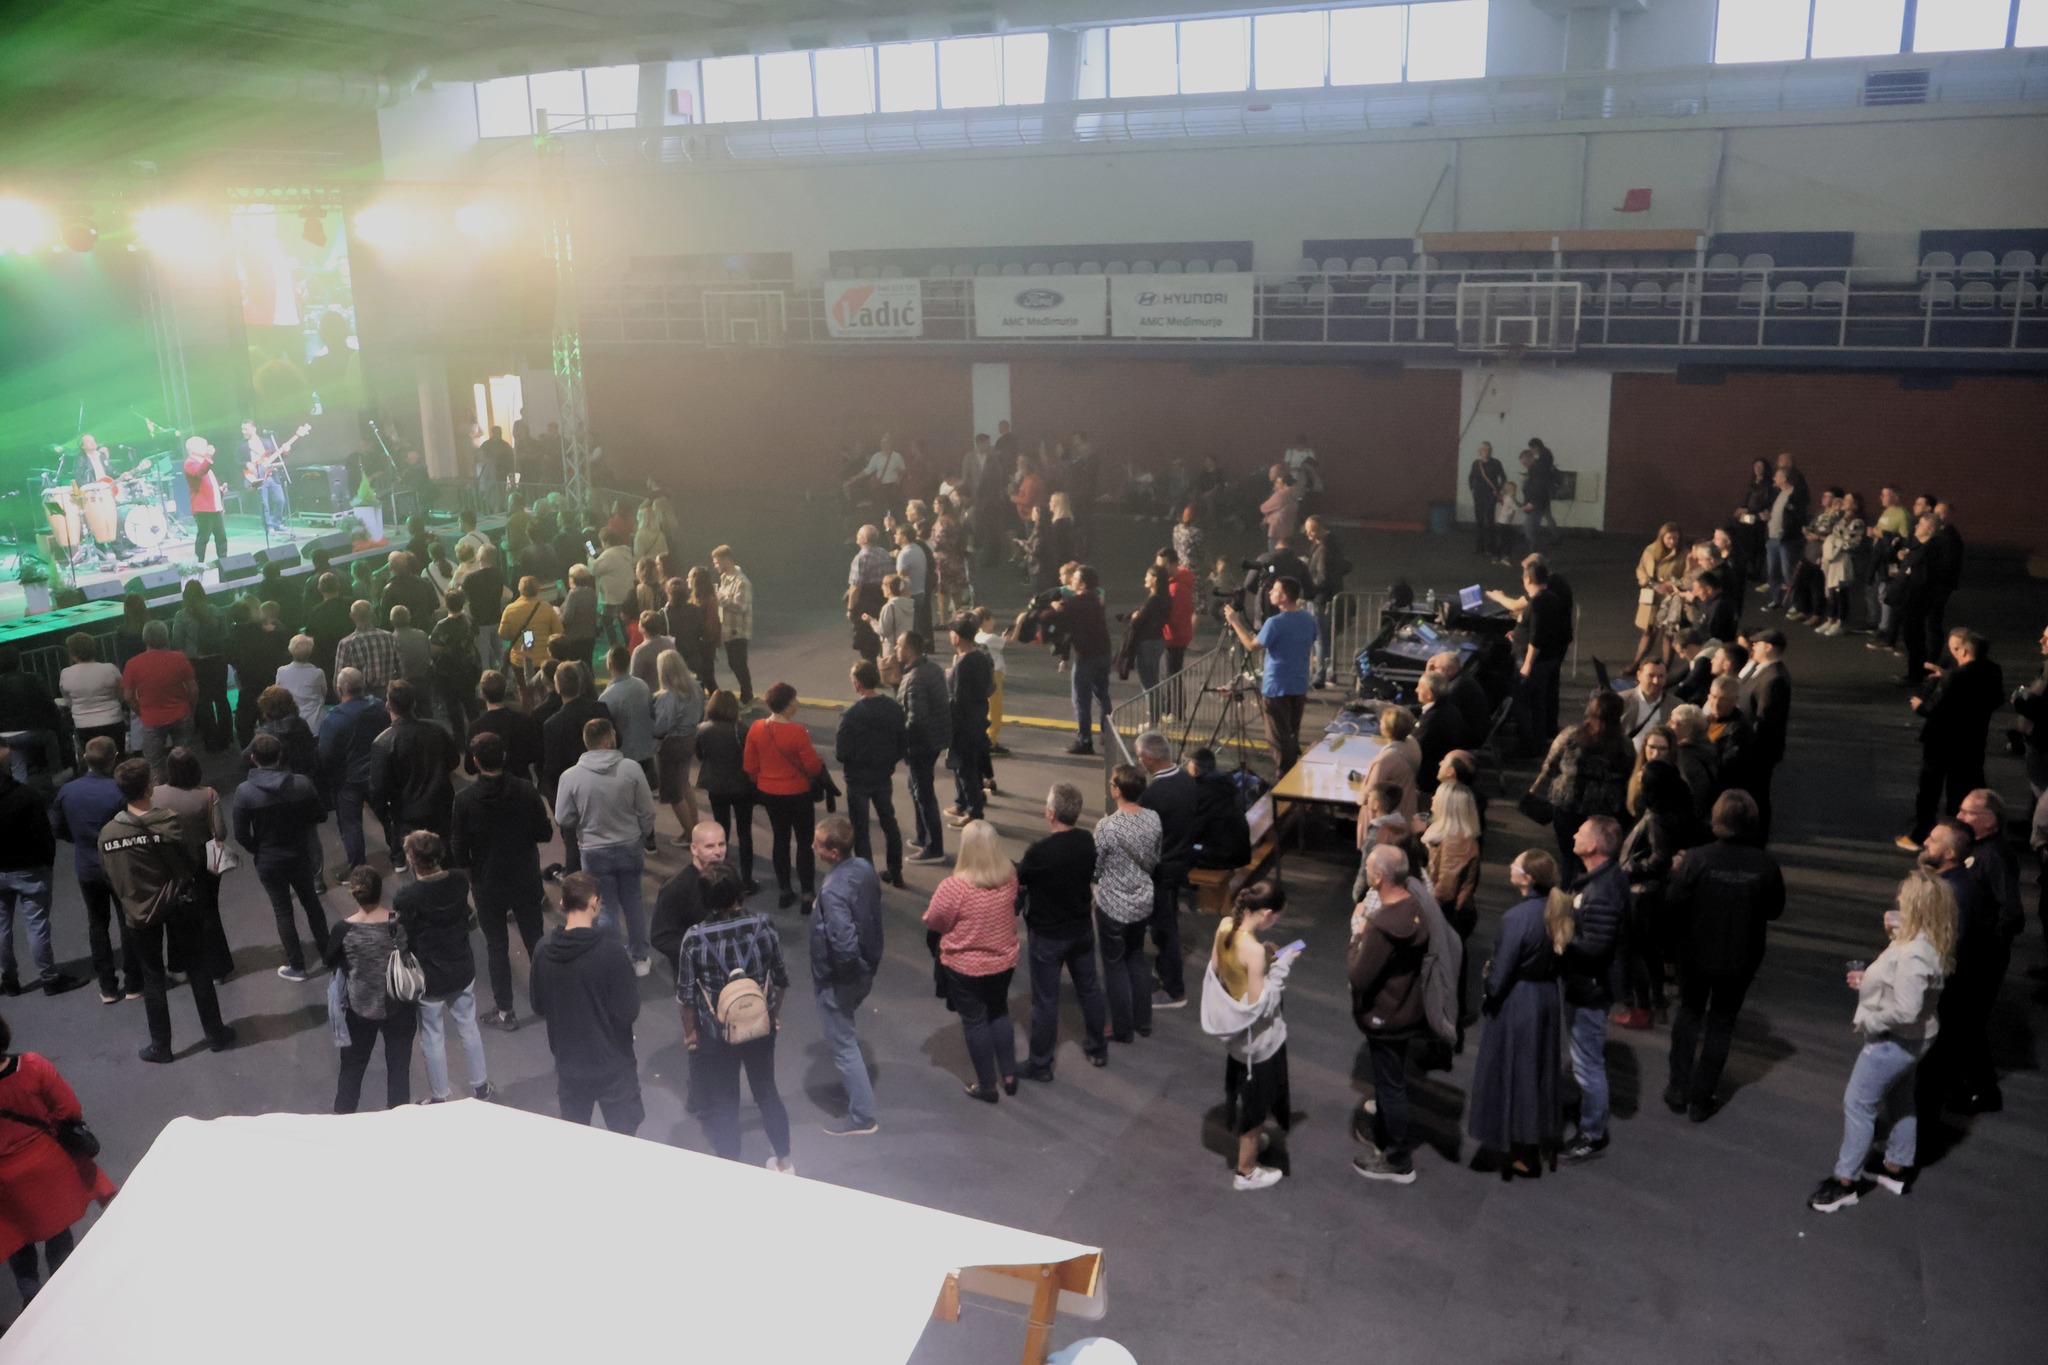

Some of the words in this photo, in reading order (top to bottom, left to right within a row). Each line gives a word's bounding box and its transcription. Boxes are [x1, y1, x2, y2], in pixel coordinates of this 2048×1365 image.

[1022, 291, 1055, 307] Ford
[1163, 293, 1228, 304] HYUNDAI
[1002, 317, 1024, 326] AMC
[1139, 317, 1164, 326] AMC
[122, 834, 161, 848] AVIATR
